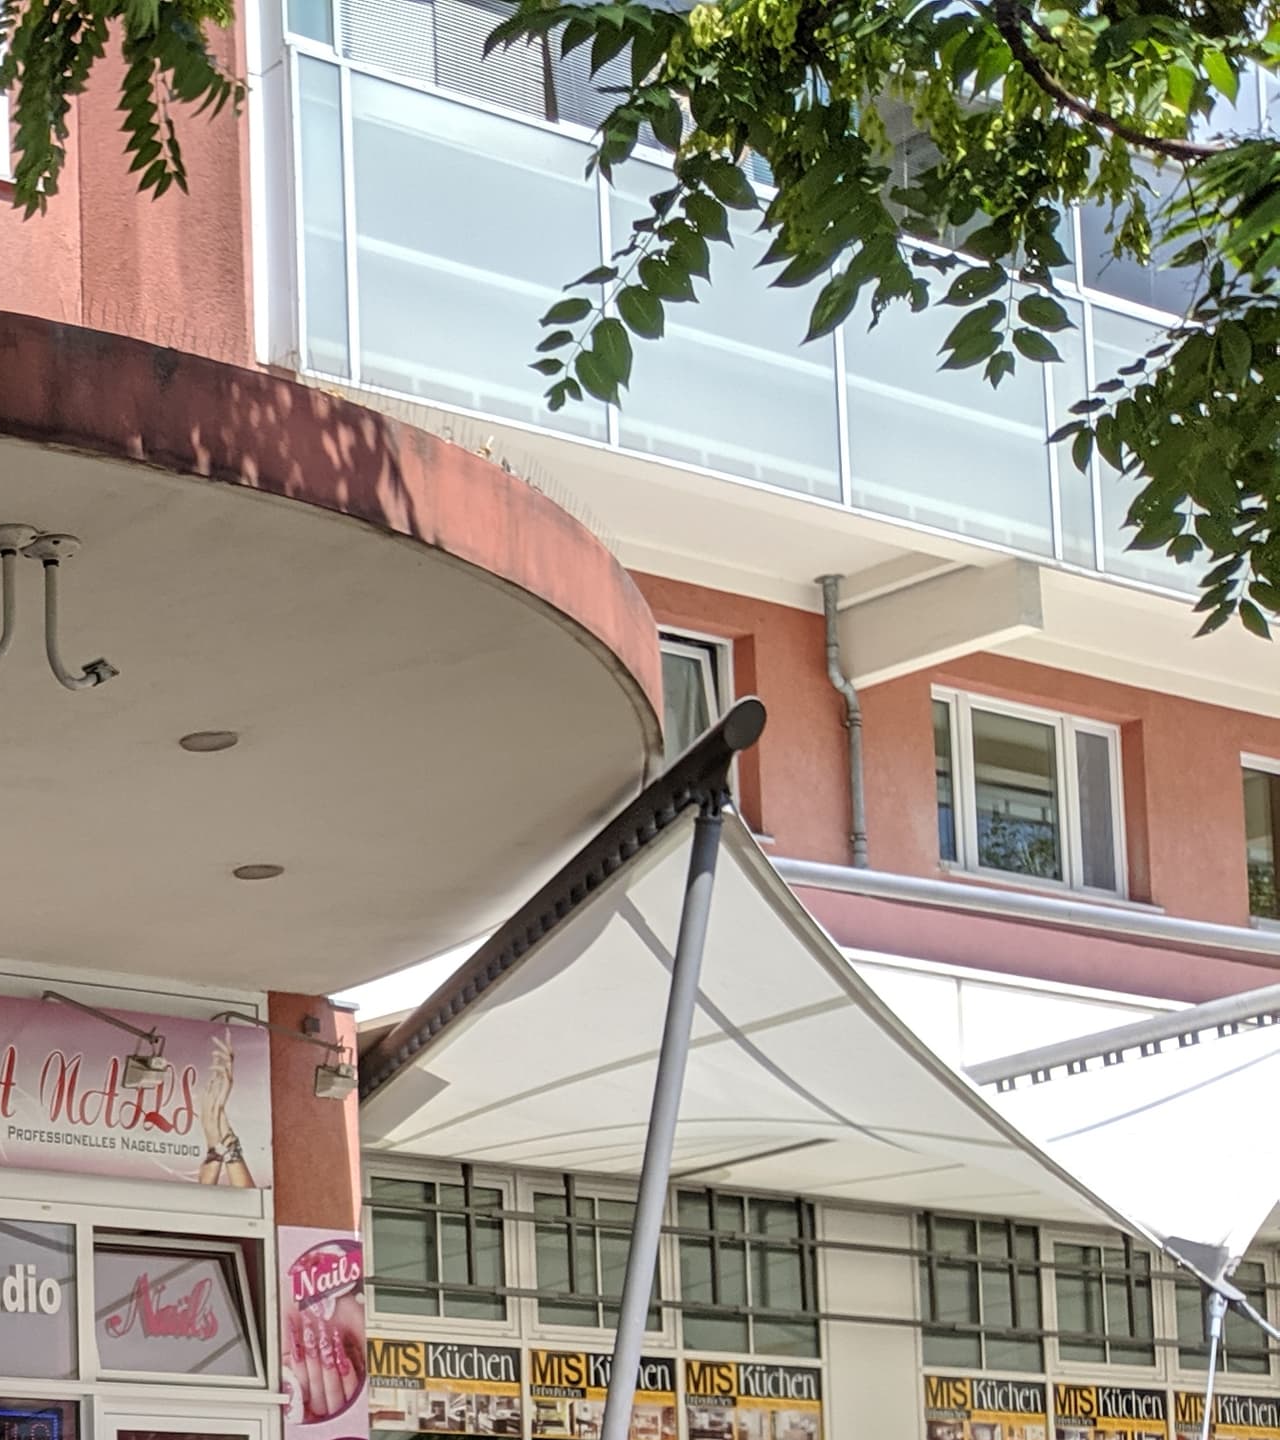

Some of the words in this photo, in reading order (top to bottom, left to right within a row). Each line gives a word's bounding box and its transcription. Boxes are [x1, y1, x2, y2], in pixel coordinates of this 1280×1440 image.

[8, 1126, 116, 1150] PROFESSIONELLES
[121, 1136, 201, 1157] NAGELSTUDIO
[296, 1257, 360, 1300] Nails
[105, 1273, 218, 1340] Nails
[368, 1340, 421, 1376] MTS
[428, 1343, 515, 1381] Küchen
[532, 1352, 583, 1386] MTS
[688, 1362, 733, 1395] MTS
[739, 1365, 817, 1400] Küchen
[928, 1378, 968, 1409] MTS
[972, 1380, 1042, 1413] Küchen
[1054, 1386, 1095, 1417] MTS
[1098, 1387, 1164, 1420] Küchen
[1217, 1395, 1279, 1428] Küchen
